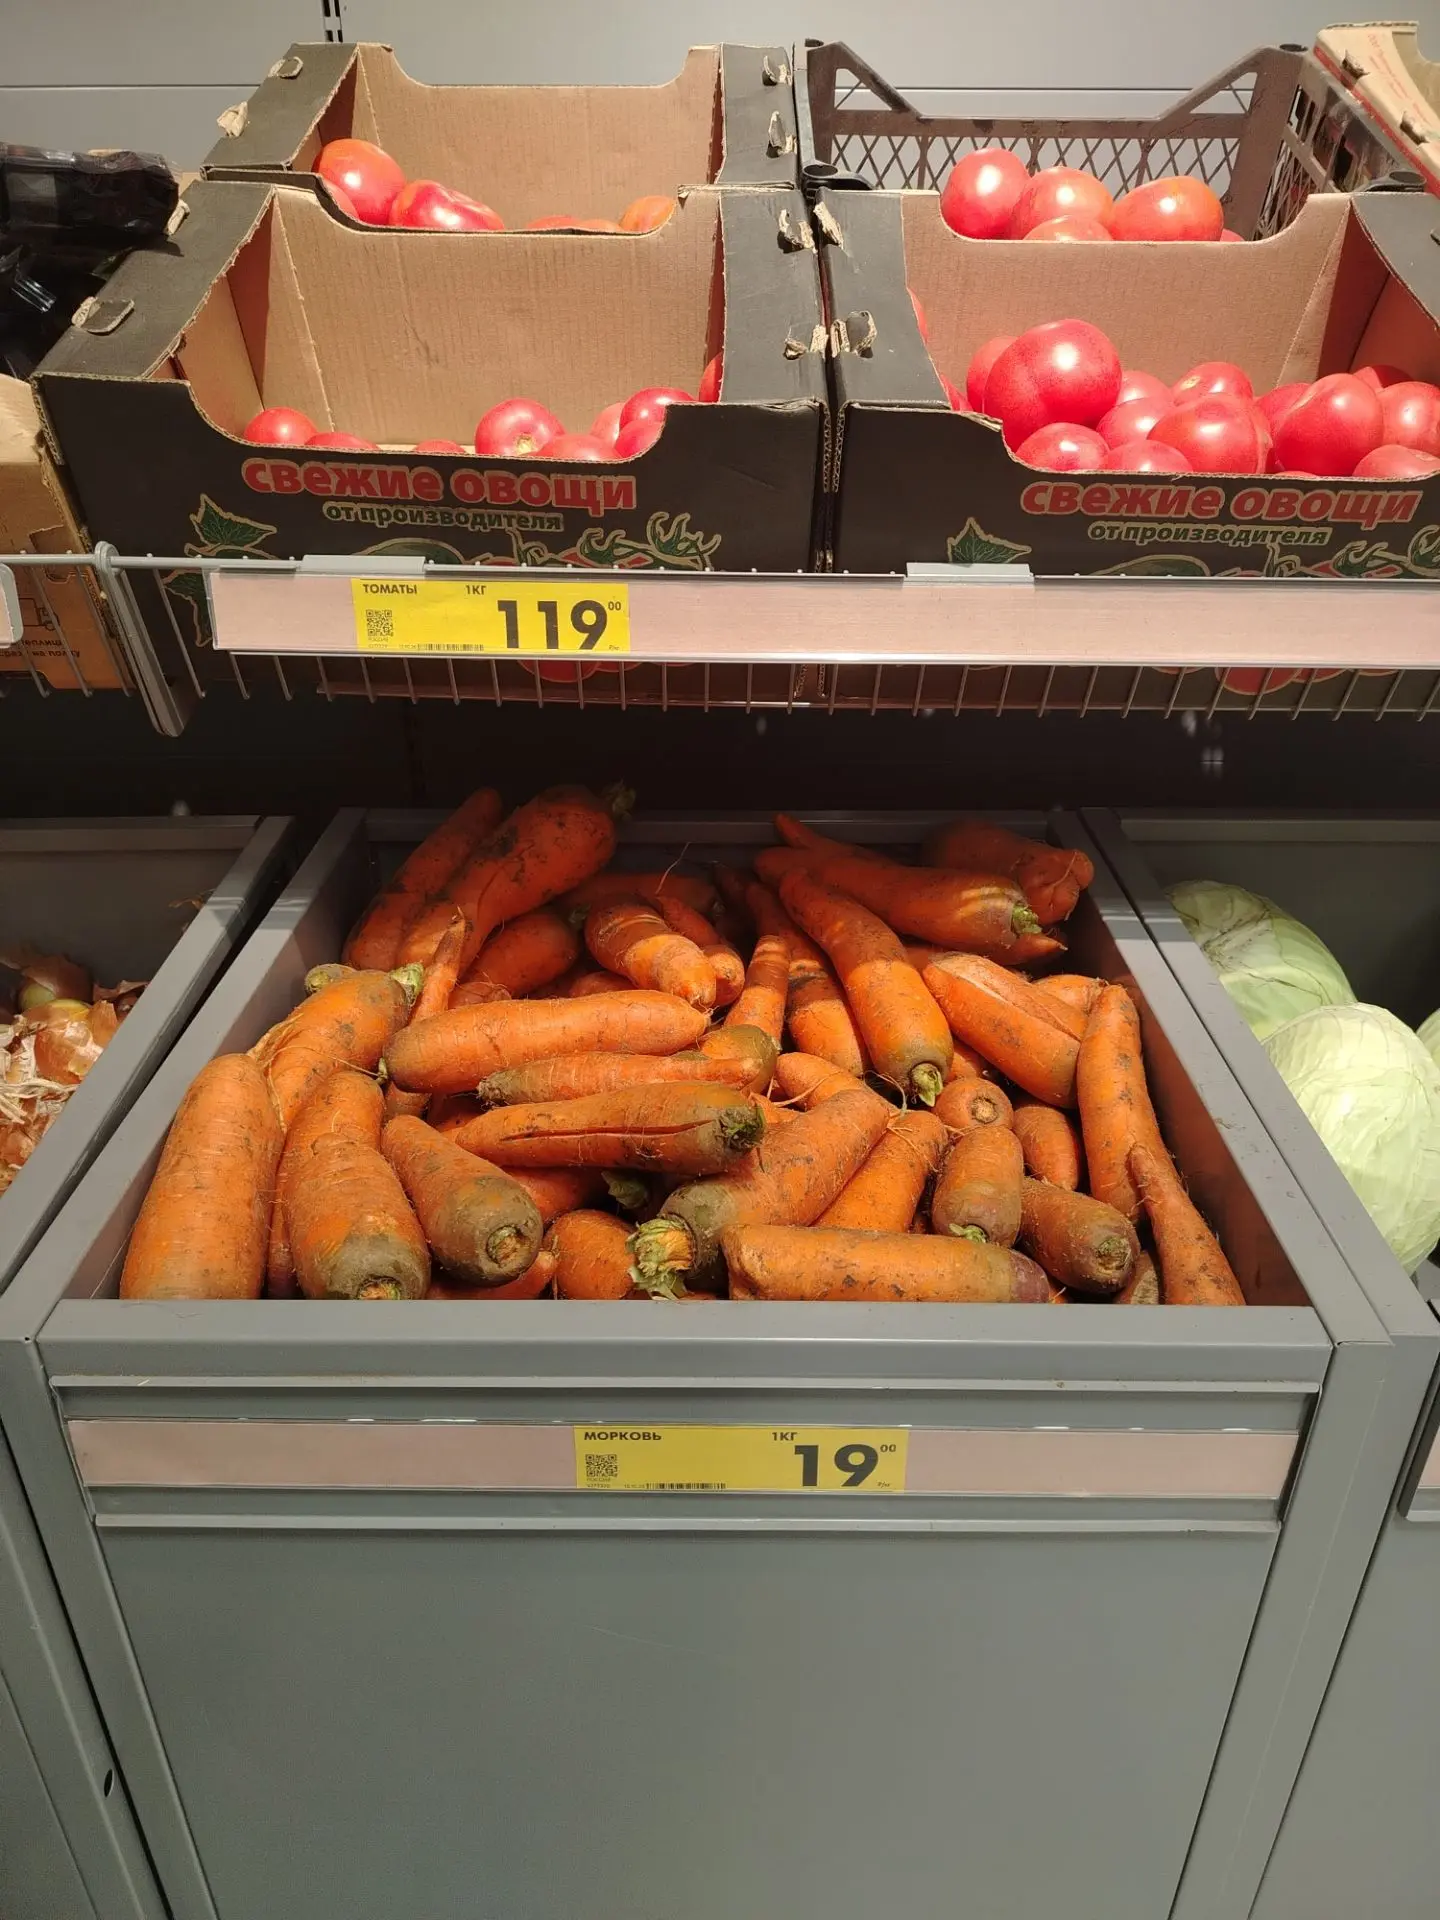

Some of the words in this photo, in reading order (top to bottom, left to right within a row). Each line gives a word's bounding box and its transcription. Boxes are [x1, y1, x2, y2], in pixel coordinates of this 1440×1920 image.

[243, 460, 442, 500] свежие
[452, 470, 635, 516] овощи
[359, 506, 562, 530] производителя
[1022, 483, 1224, 518] свежие
[1231, 489, 1421, 529] овощи
[1123, 525, 1328, 545] производителя
[363, 584, 417, 594] ТОМАТЫ
[465, 585, 486, 595] 1КГ
[497, 600, 607, 650] 119
[608, 601, 621, 611] 00
[584, 1432, 662, 1440] МОРКОВЬ
[772, 1432, 797, 1441] 1КГ
[794, 1444, 879, 1487] 19
[880, 1444, 897, 1453] 00
